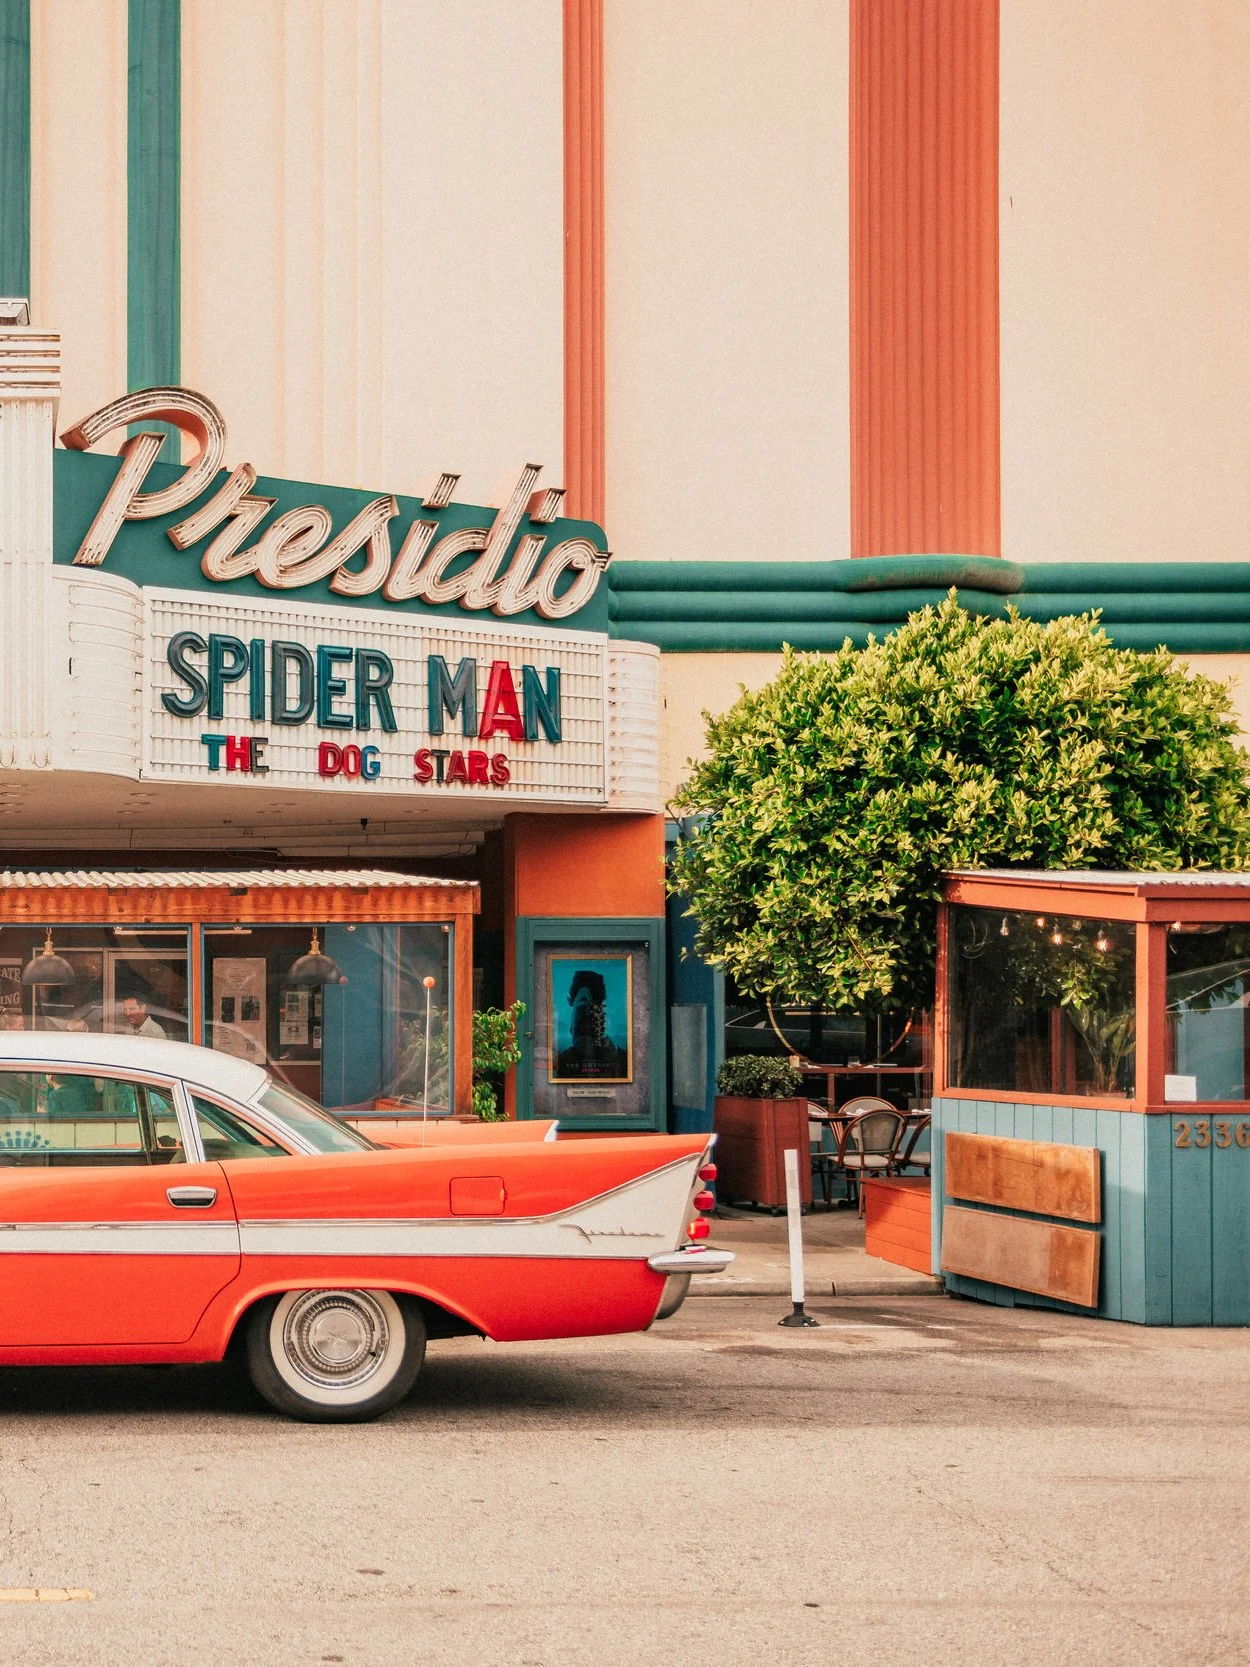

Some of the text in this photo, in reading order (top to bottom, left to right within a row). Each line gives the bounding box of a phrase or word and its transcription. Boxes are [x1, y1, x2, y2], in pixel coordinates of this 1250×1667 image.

[60, 386, 613, 618] Presidio
[161, 631, 563, 745] SPIDER MAN
[200, 733, 511, 786] THE DOG STARS
[1174, 1121, 1250, 1149] 2336
